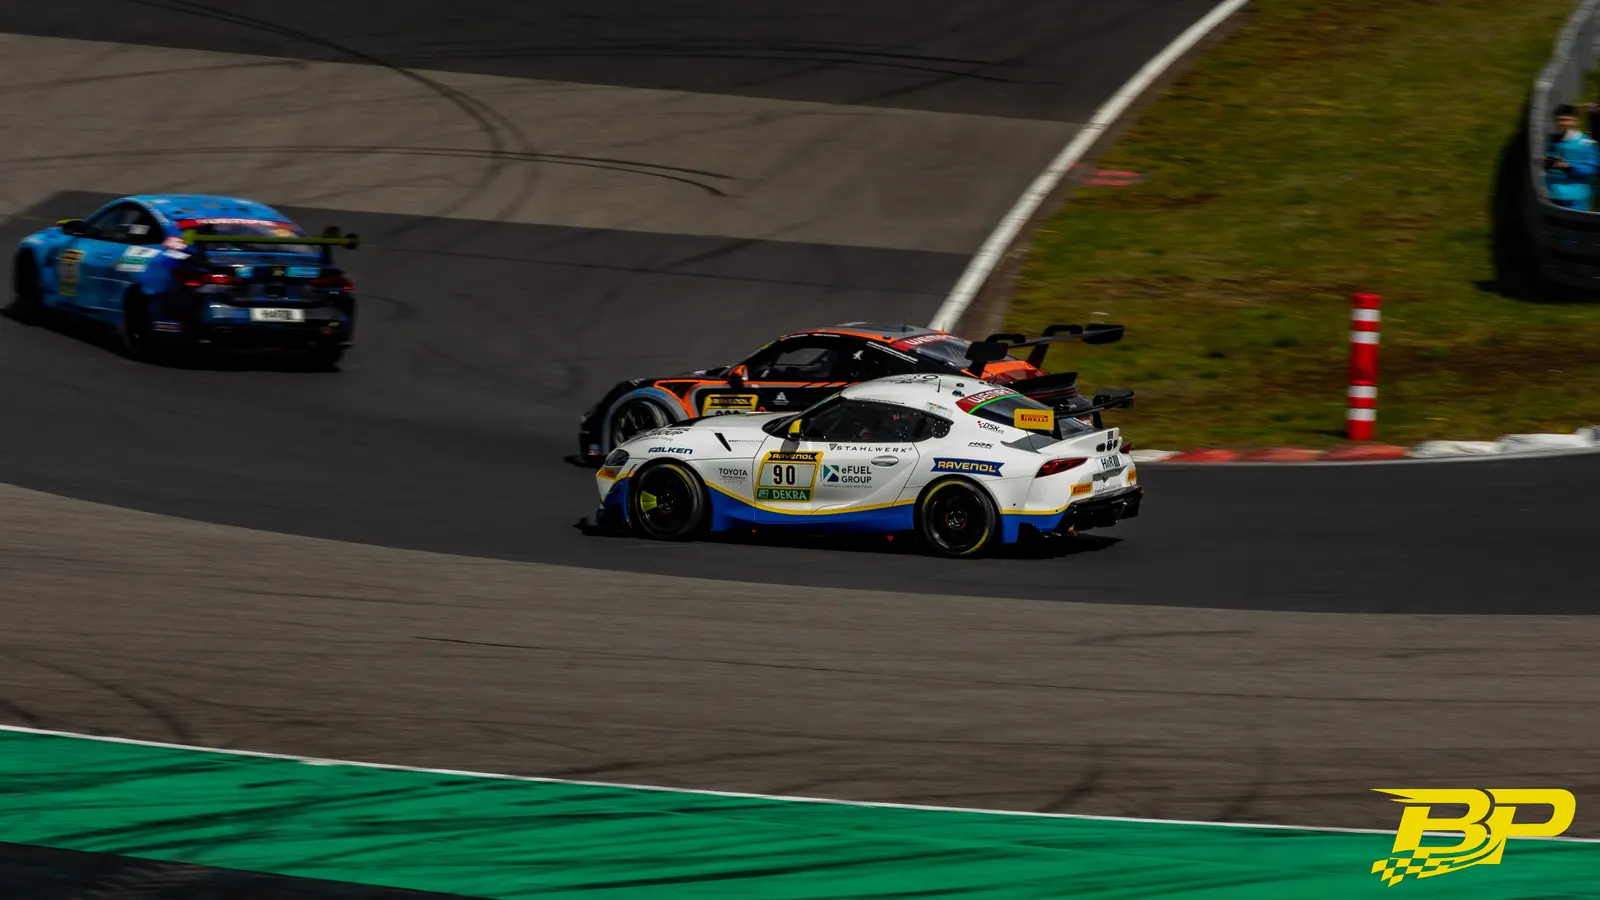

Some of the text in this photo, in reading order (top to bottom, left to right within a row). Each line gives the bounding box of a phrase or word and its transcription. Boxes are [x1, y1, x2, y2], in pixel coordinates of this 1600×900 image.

[836, 445, 907, 453] STAHLWERK
[841, 465, 872, 474] eFUEL
[937, 461, 998, 473] RAVENOL
[719, 468, 748, 476] TOYOTA
[773, 464, 795, 485] 90
[841, 475, 872, 483] GROUP
[772, 490, 807, 500] DEKRA
